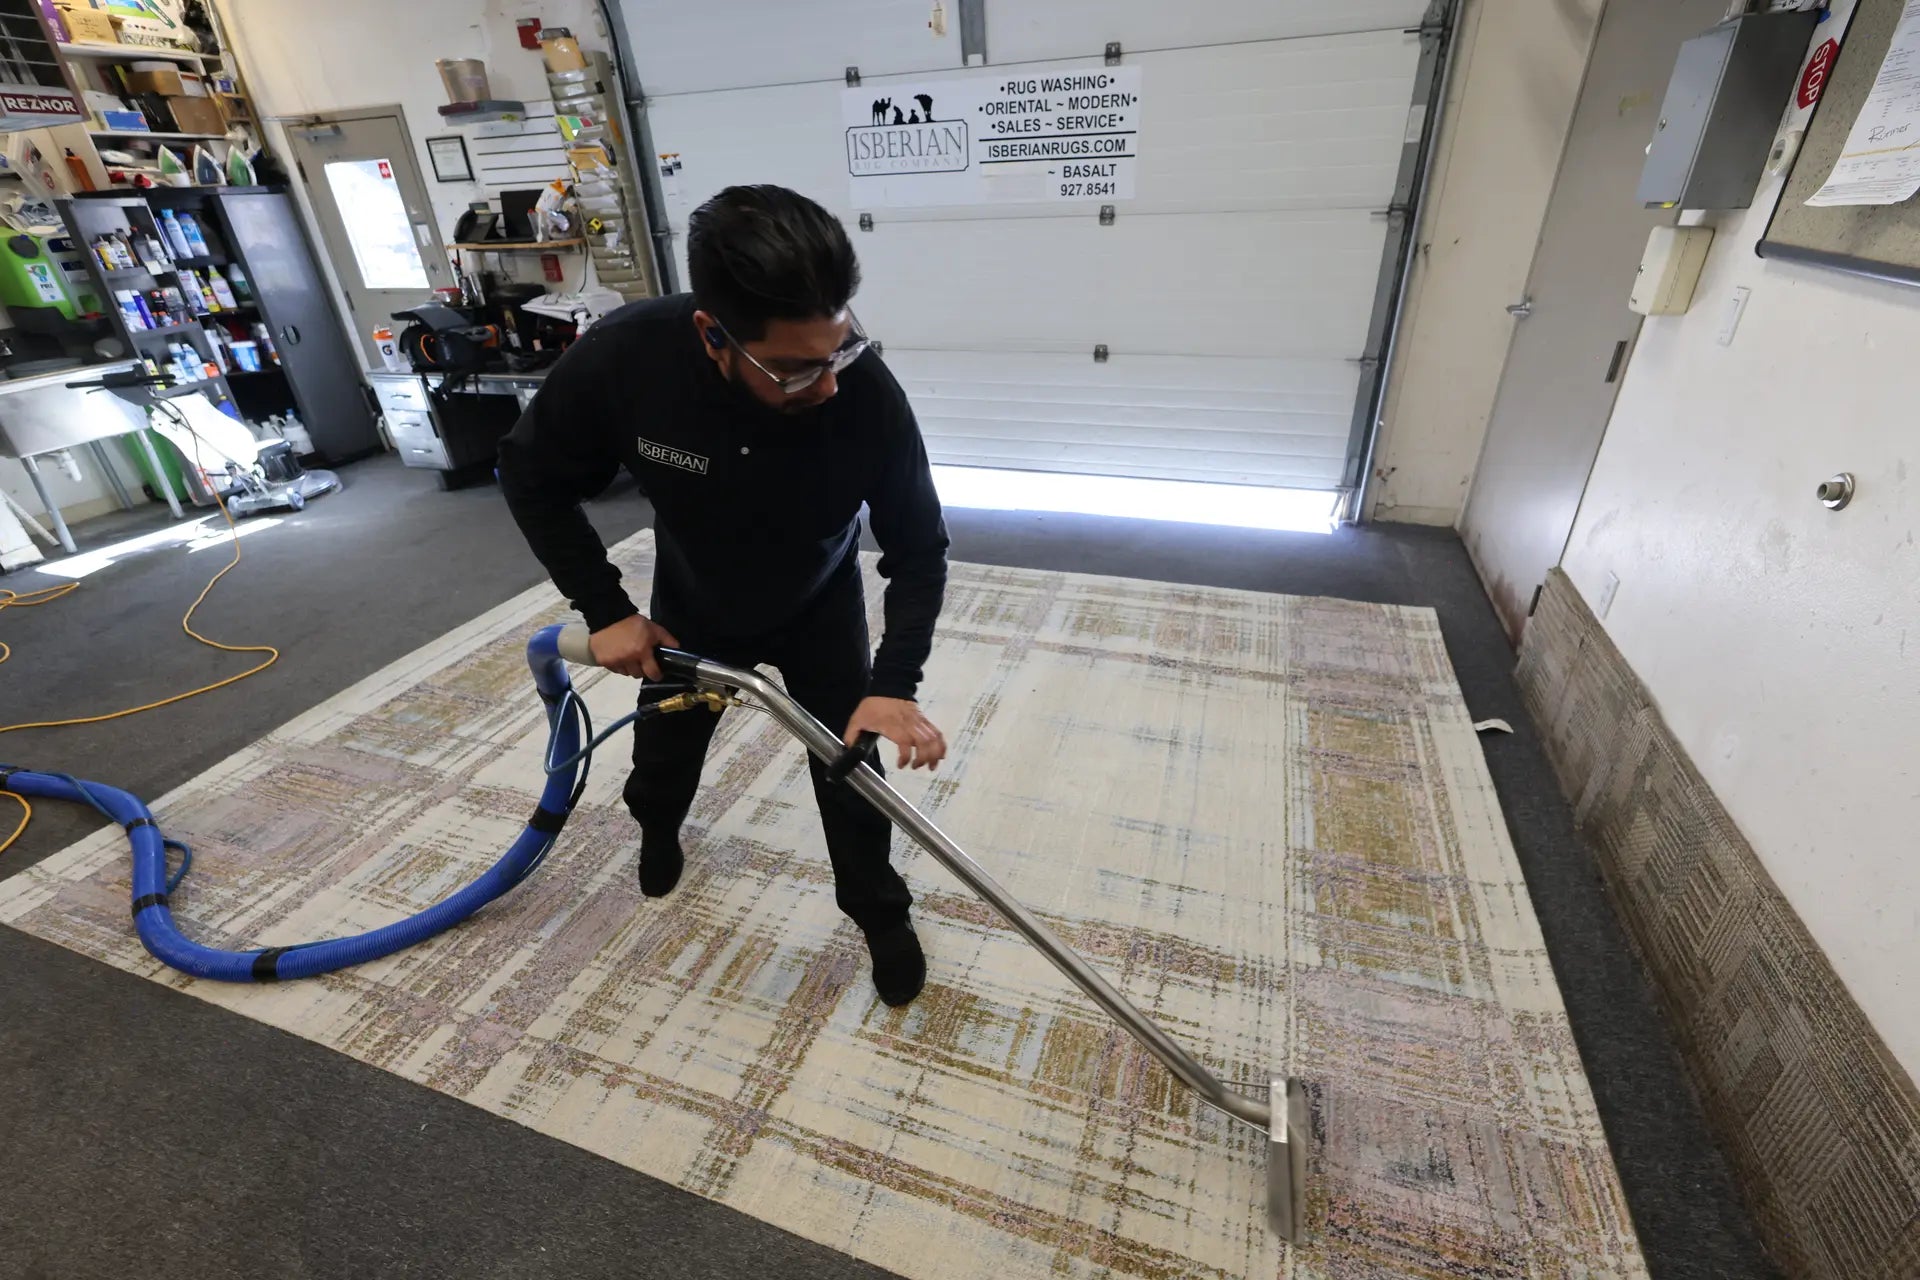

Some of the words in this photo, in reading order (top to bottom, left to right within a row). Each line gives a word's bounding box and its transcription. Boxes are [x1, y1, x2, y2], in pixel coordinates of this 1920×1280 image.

[1805, 44, 1830, 101] STOP
[1007, 80, 1037, 95] RUG
[1041, 75, 1108, 93] WASHING
[3, 97, 77, 112] REZNOR
[985, 99, 1052, 116] ORIENTAL
[1068, 93, 1131, 110] MODERN
[997, 118, 1041, 133] SALES
[1056, 114, 1117, 130] SERVICE
[851, 127, 963, 160] ISBERIAN
[988, 138, 1126, 158] ISBERIANRUGS.COM
[854, 161, 881, 170] RUG
[1063, 164, 1117, 178] BASALT
[1060, 182, 1115, 196] 927.8541
[641, 441, 706, 471] ISBERIAN
